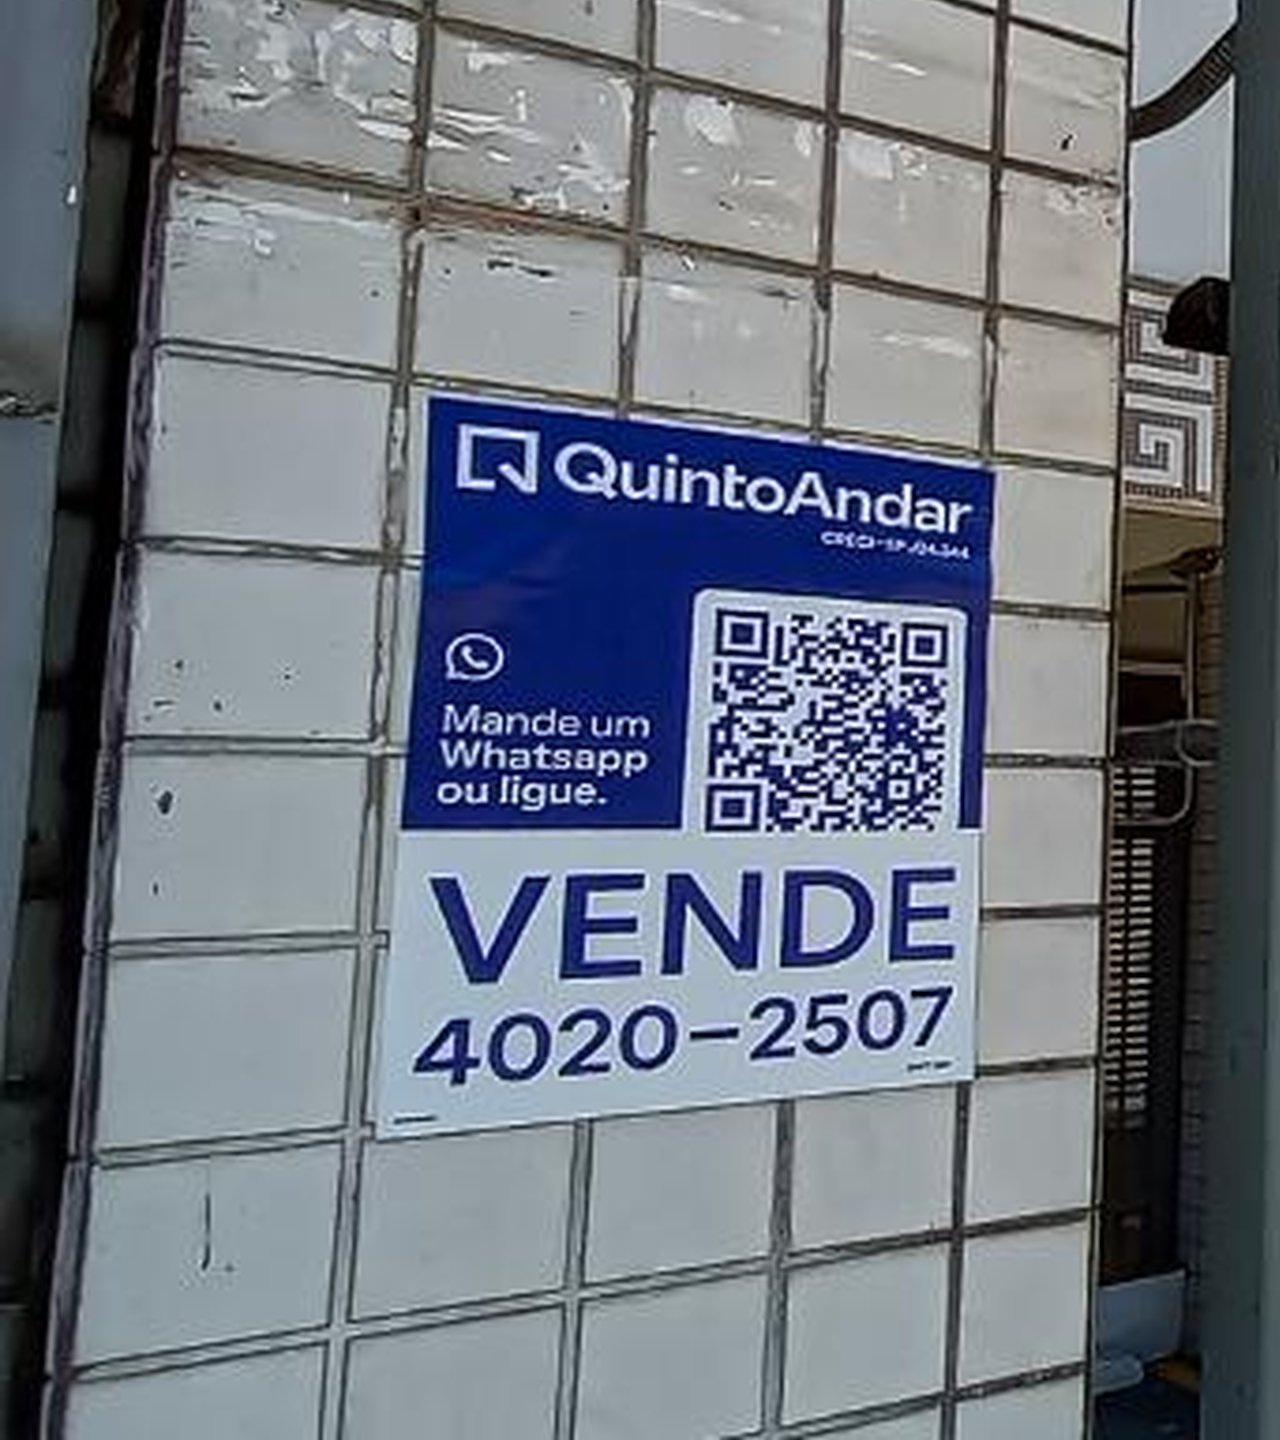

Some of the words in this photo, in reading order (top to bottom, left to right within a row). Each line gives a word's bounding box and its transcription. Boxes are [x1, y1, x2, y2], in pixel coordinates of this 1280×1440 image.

[554, 441, 974, 535] QuintoAndar
[441, 704, 581, 739] Mande
[590, 713, 651, 739] um
[441, 738, 648, 779] Whatsapp
[436, 778, 491, 806] ou
[499, 775, 607, 812] ligue.
[429, 866, 958, 985] VENDE
[411, 985, 955, 1087] 4020-2507
